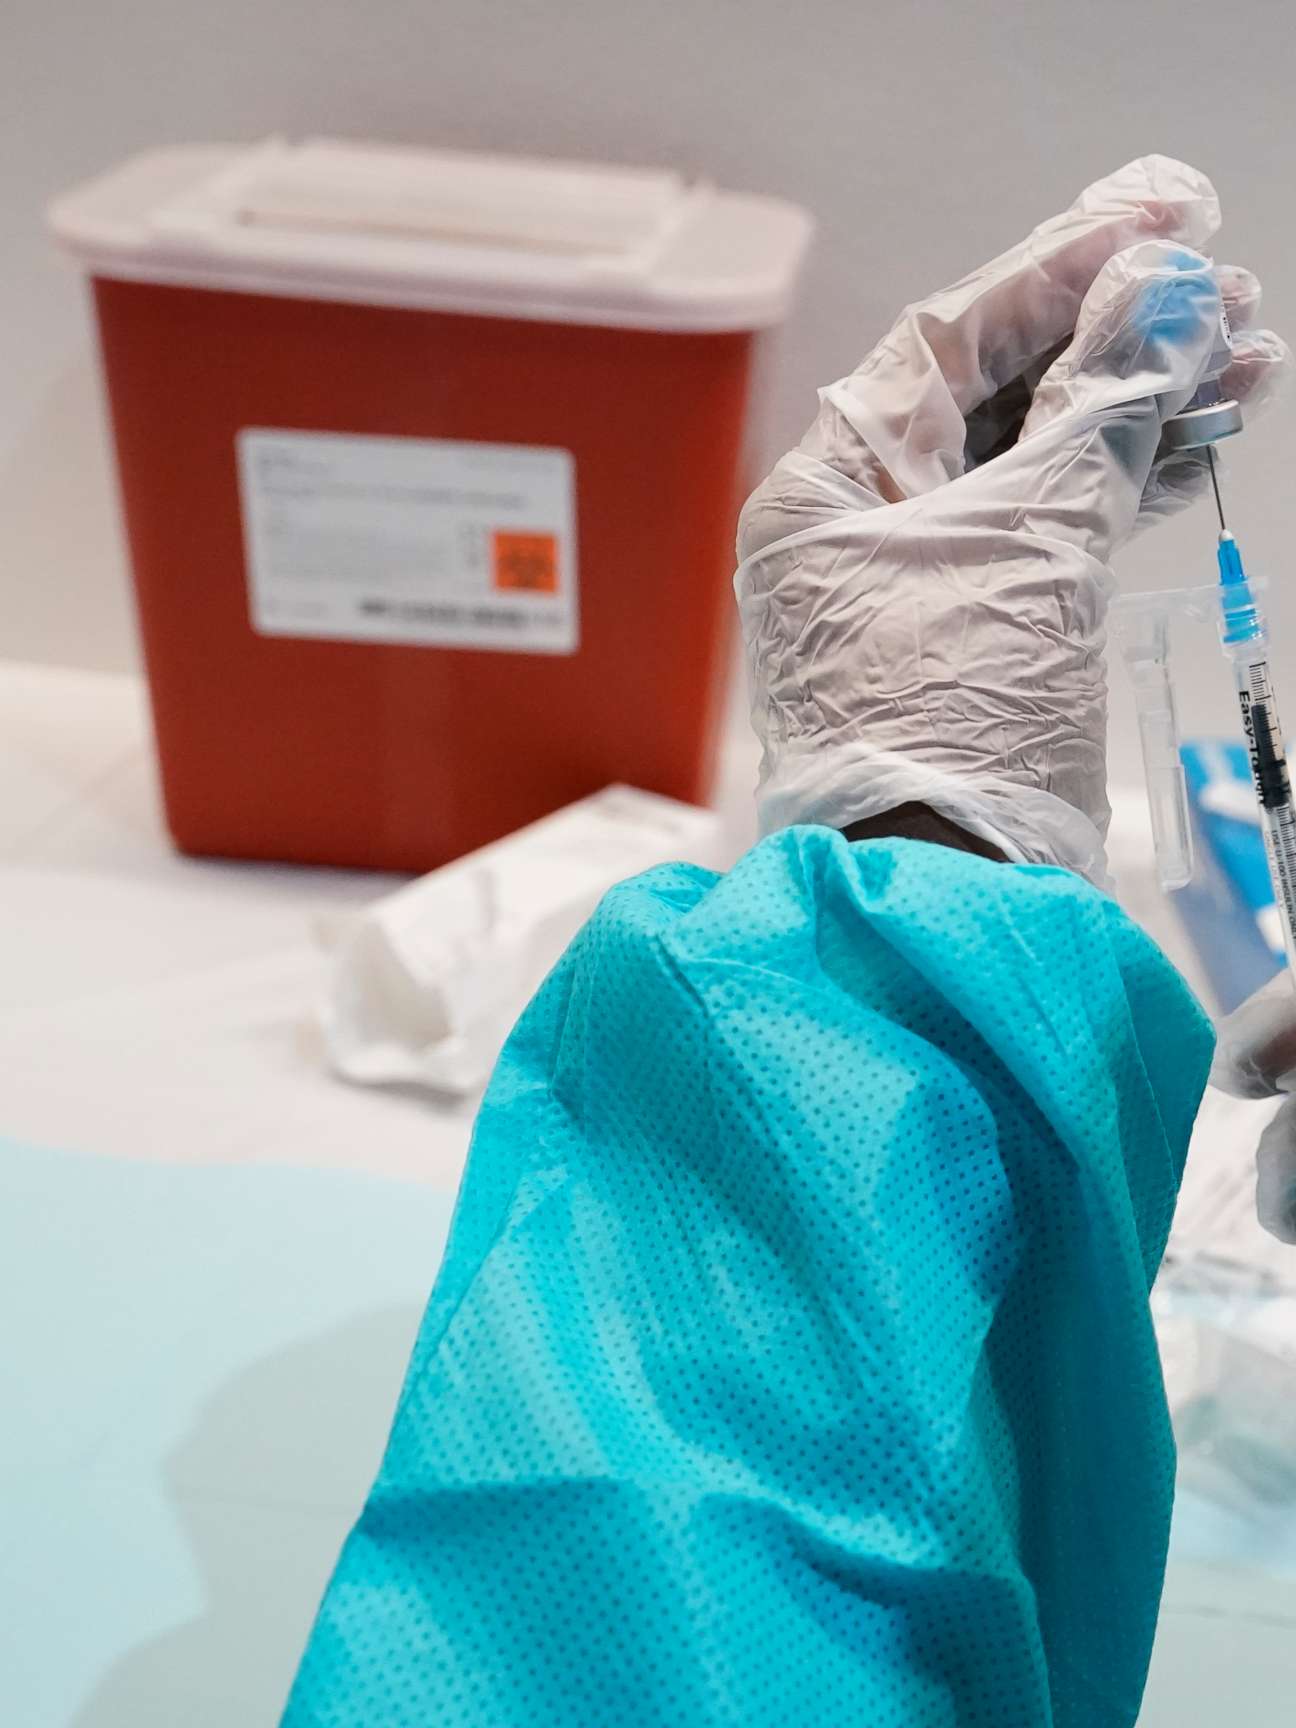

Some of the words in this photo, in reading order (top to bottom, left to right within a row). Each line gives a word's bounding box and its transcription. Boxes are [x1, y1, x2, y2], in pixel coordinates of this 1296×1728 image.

[1271, 830, 1281, 845] USE
[1275, 849, 1287, 877] U-100
[1281, 879, 1293, 914] INSULIN
